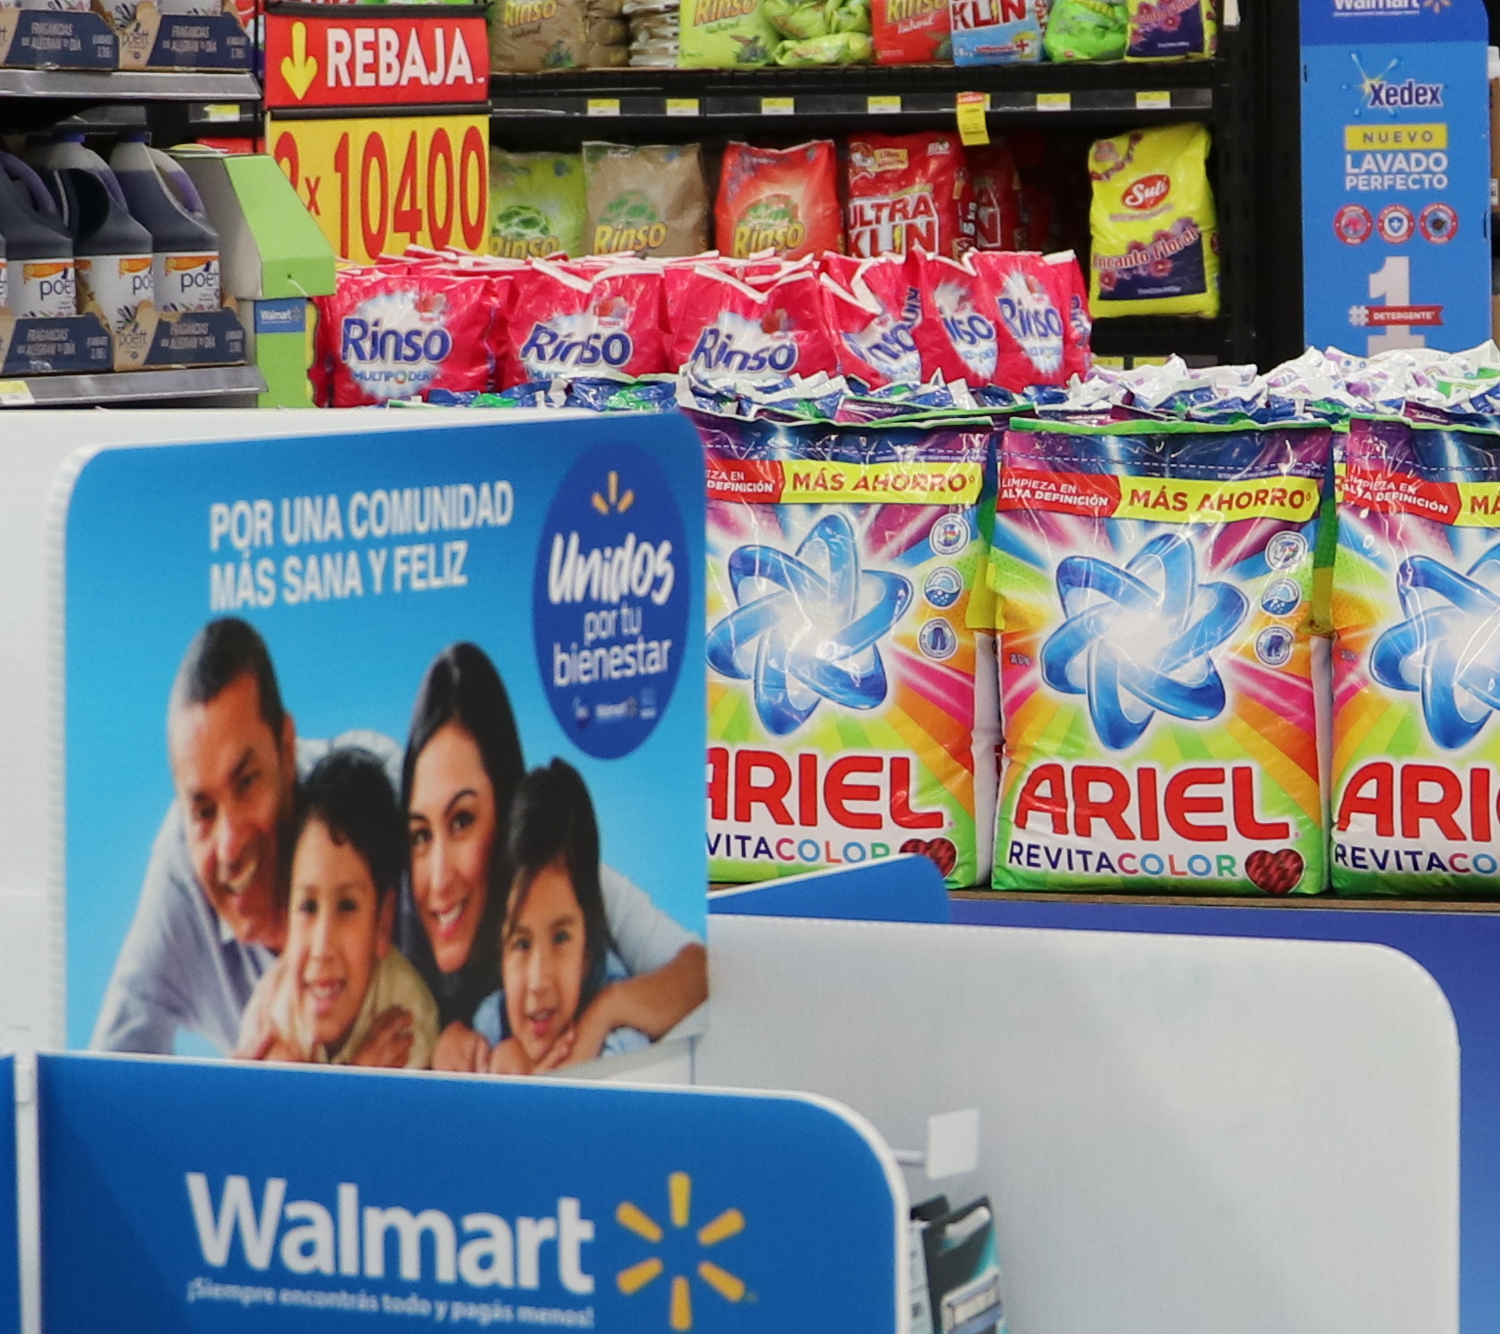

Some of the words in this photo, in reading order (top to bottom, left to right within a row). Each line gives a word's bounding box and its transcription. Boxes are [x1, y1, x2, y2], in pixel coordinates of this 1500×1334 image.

[326, 28, 472, 88] REBAJA
[1368, 78, 1444, 108] Xedex
[1362, 130, 1435, 144] NUEVO
[1345, 152, 1448, 174] LAVADO
[334, 125, 488, 261] 10400
[1345, 174, 1449, 191] PERFECTO
[340, 318, 450, 365] Rinso
[1002, 478, 1056, 491] LIMPIEZA
[1060, 484, 1077, 494] EN
[1002, 488, 1033, 500] ALTA
[1035, 491, 1109, 508] DEFINICIÓN
[1129, 487, 1188, 512] MÁS
[1197, 488, 1305, 513] AHORRO
[1015, 761, 1292, 841] ARIEL
[1008, 841, 1239, 879] REVITACOLOR
[186, 1172, 595, 1295] Walmart
